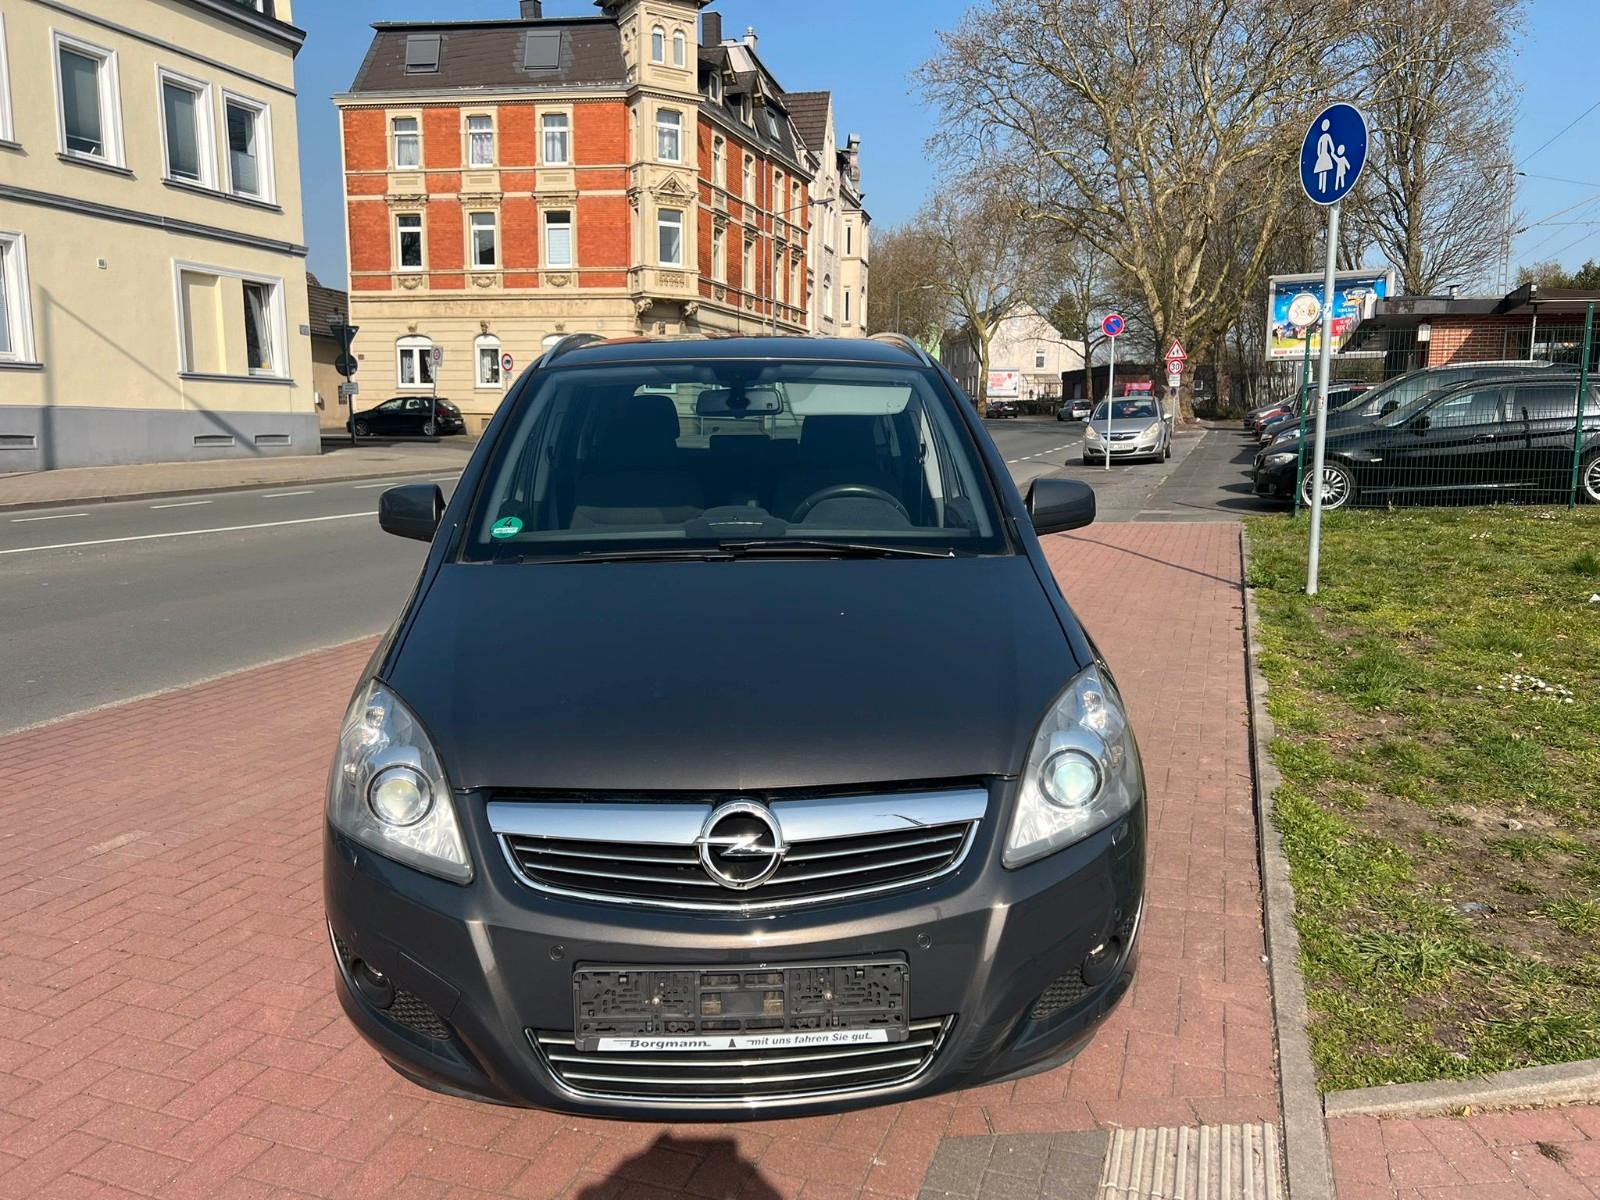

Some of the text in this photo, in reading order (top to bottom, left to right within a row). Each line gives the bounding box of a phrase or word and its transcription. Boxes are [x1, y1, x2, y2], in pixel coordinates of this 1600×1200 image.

[1171, 363, 1180, 371] 30
[750, 1037, 769, 1046] mit
[772, 1037, 791, 1045] uns
[795, 1035, 829, 1044] fahren
[832, 1033, 849, 1041] Sie
